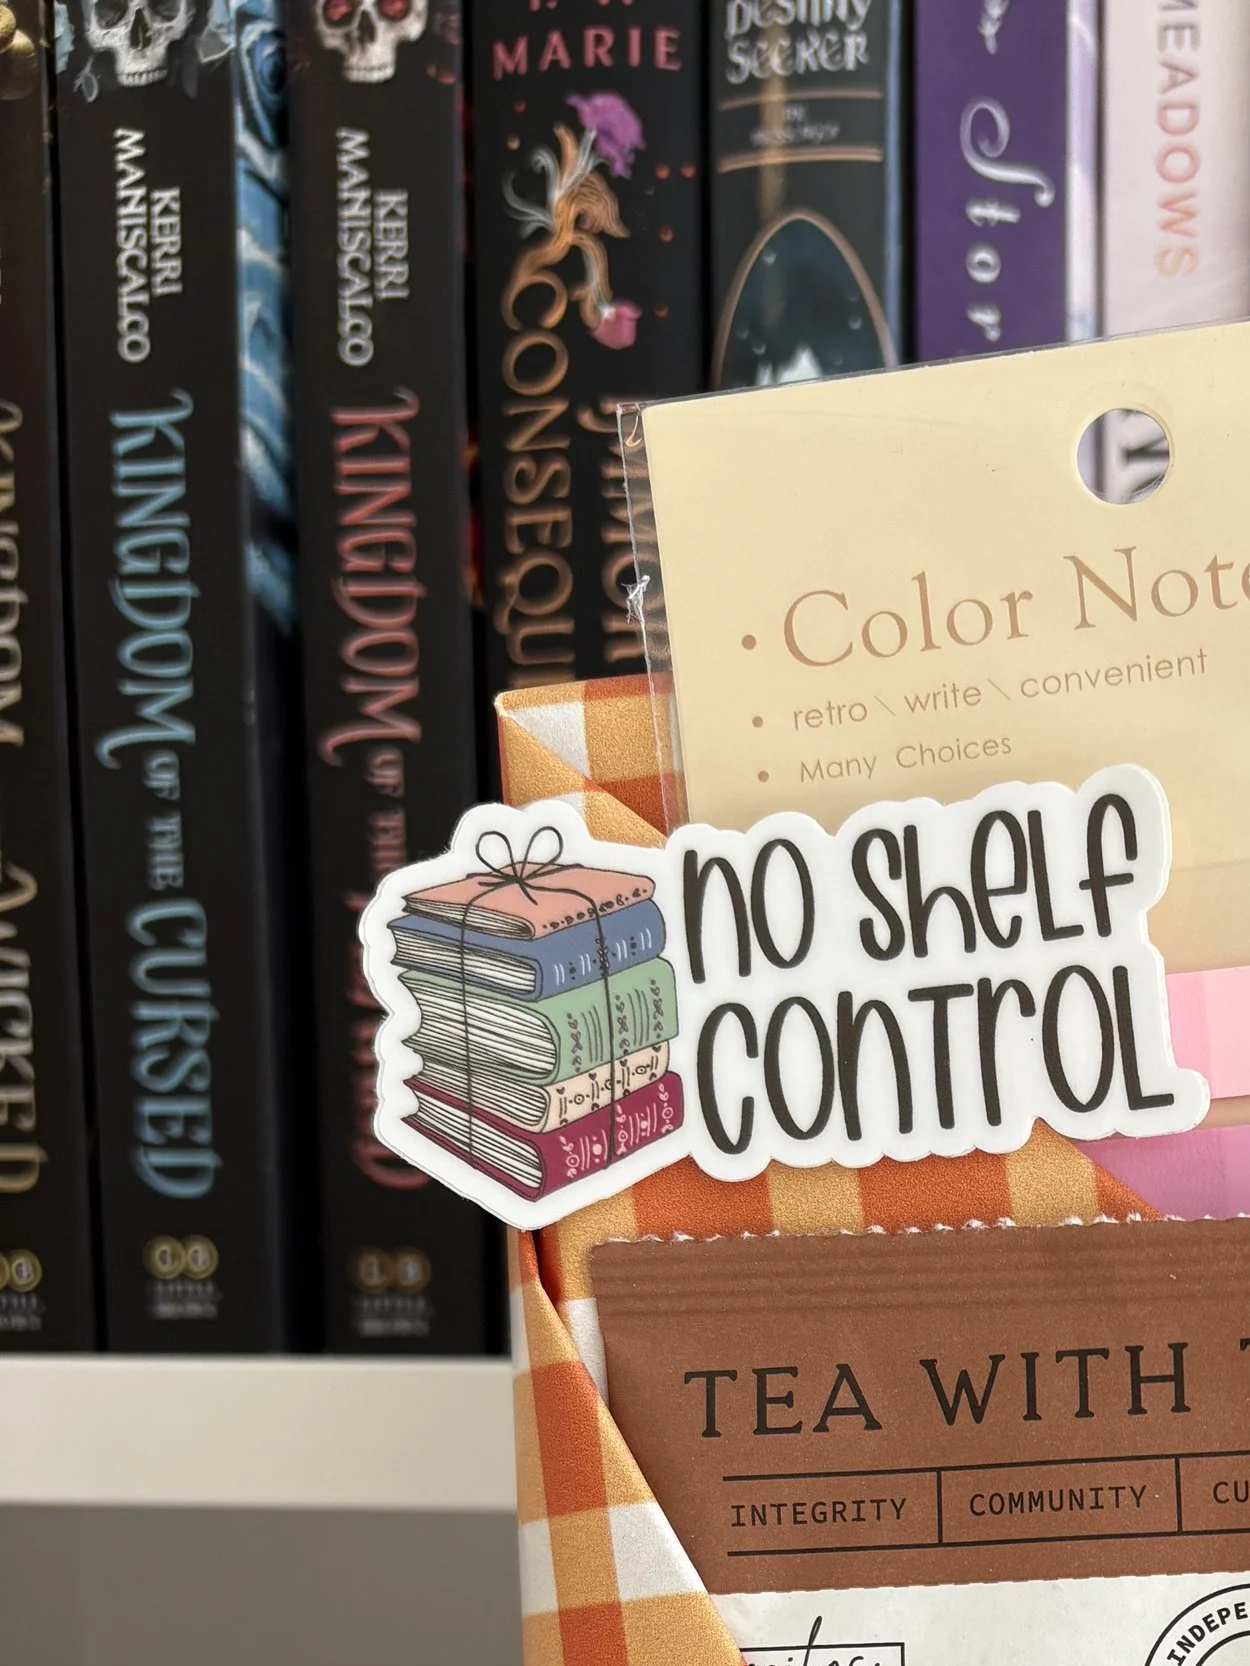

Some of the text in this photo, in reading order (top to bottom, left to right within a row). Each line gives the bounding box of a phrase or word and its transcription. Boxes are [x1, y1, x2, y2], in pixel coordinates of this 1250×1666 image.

[492, 24, 683, 82] MARIE
[114, 128, 151, 363] MANISCALCO
[151, 187, 183, 297] KERRI
[335, 128, 374, 366] MANISCALCO
[373, 189, 410, 299] KERRI
[98, 389, 201, 768] KINGDOM
[320, 389, 426, 766] KINGDOM
[783, 571, 1032, 668] Color
[792, 648, 1208, 732] retro write convenient
[143, 750, 180, 799] OF
[363, 748, 405, 798] OF
[799, 734, 1013, 787] Many Choices
[146, 812, 184, 890] THE
[126, 898, 223, 1200] CURSED
[683, 1364, 882, 1438] TEA
[921, 1343, 1193, 1426] WITH
[729, 1497, 909, 1528] INTEGRITY
[969, 1485, 1148, 1517] COMMUNITY
